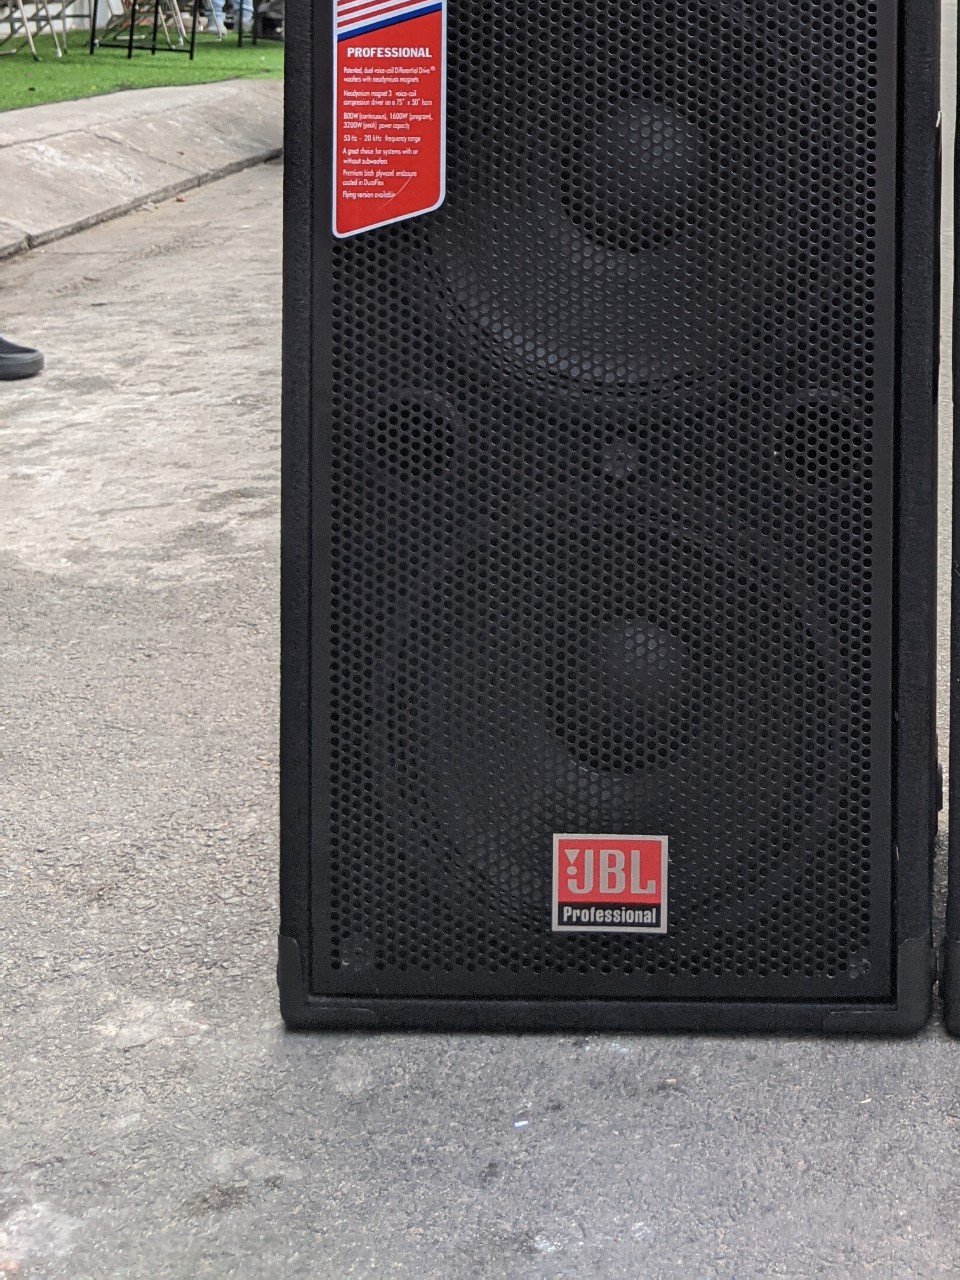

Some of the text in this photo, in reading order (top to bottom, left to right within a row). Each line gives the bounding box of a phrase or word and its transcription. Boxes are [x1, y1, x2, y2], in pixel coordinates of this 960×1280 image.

[347, 47, 432, 58] PROFESSIONAL
[565, 849, 657, 894] JBL
[562, 906, 657, 924] Professional
